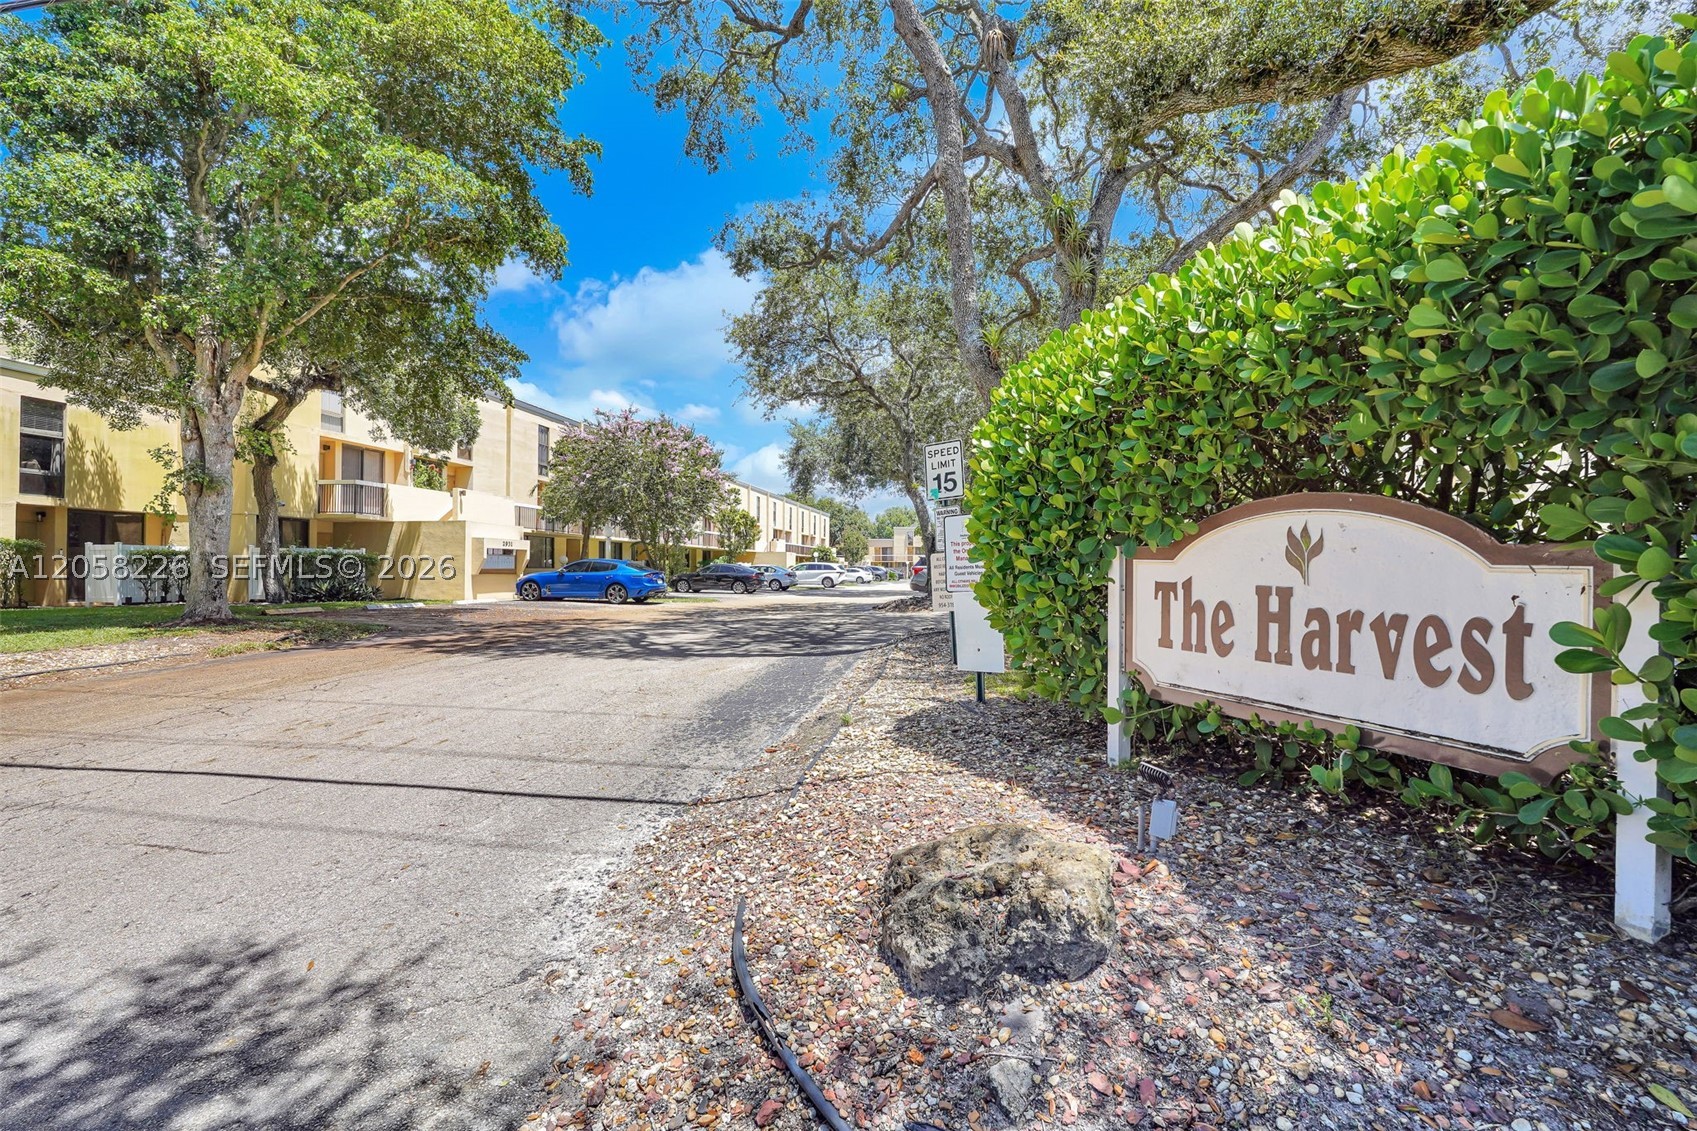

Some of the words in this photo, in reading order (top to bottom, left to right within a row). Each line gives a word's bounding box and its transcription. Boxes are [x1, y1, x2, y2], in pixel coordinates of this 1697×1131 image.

[927, 446, 960, 459] SPEED
[931, 458, 956, 470] LIMIT
[932, 471, 958, 494] 15
[936, 508, 959, 516] WARNING
[1154, 576, 1236, 658] The
[1254, 585, 1535, 701] Harvest
